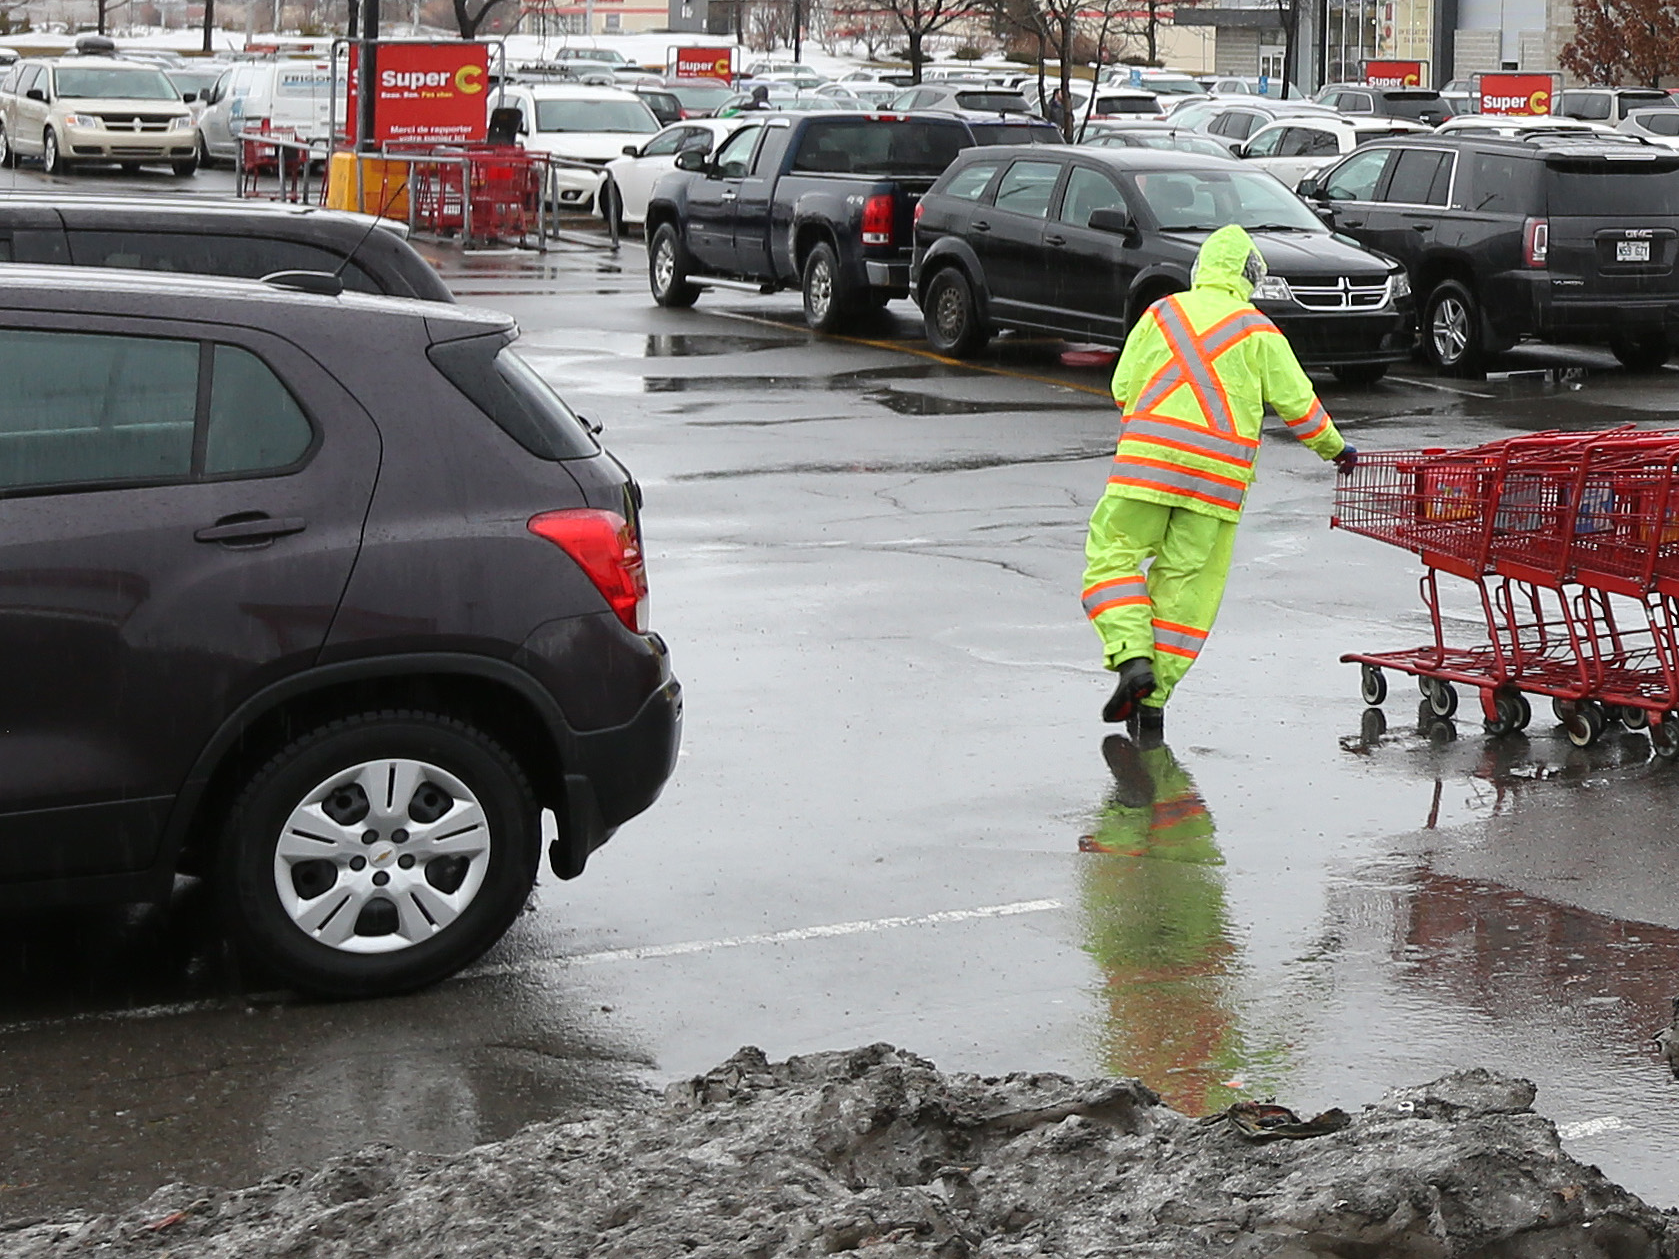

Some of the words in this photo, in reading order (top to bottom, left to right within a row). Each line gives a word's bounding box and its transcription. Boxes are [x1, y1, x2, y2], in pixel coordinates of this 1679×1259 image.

[679, 61, 714, 73] Super
[715, 59, 728, 75] C
[382, 70, 450, 90] Super
[455, 65, 482, 94] C
[1368, 76, 1403, 87] Super
[1404, 74, 1418, 87] C
[1483, 95, 1528, 111] Super
[1529, 91, 1549, 114] C
[390, 125, 415, 133] Merci
[417, 125, 429, 133] de
[430, 125, 473, 136] rapporter
